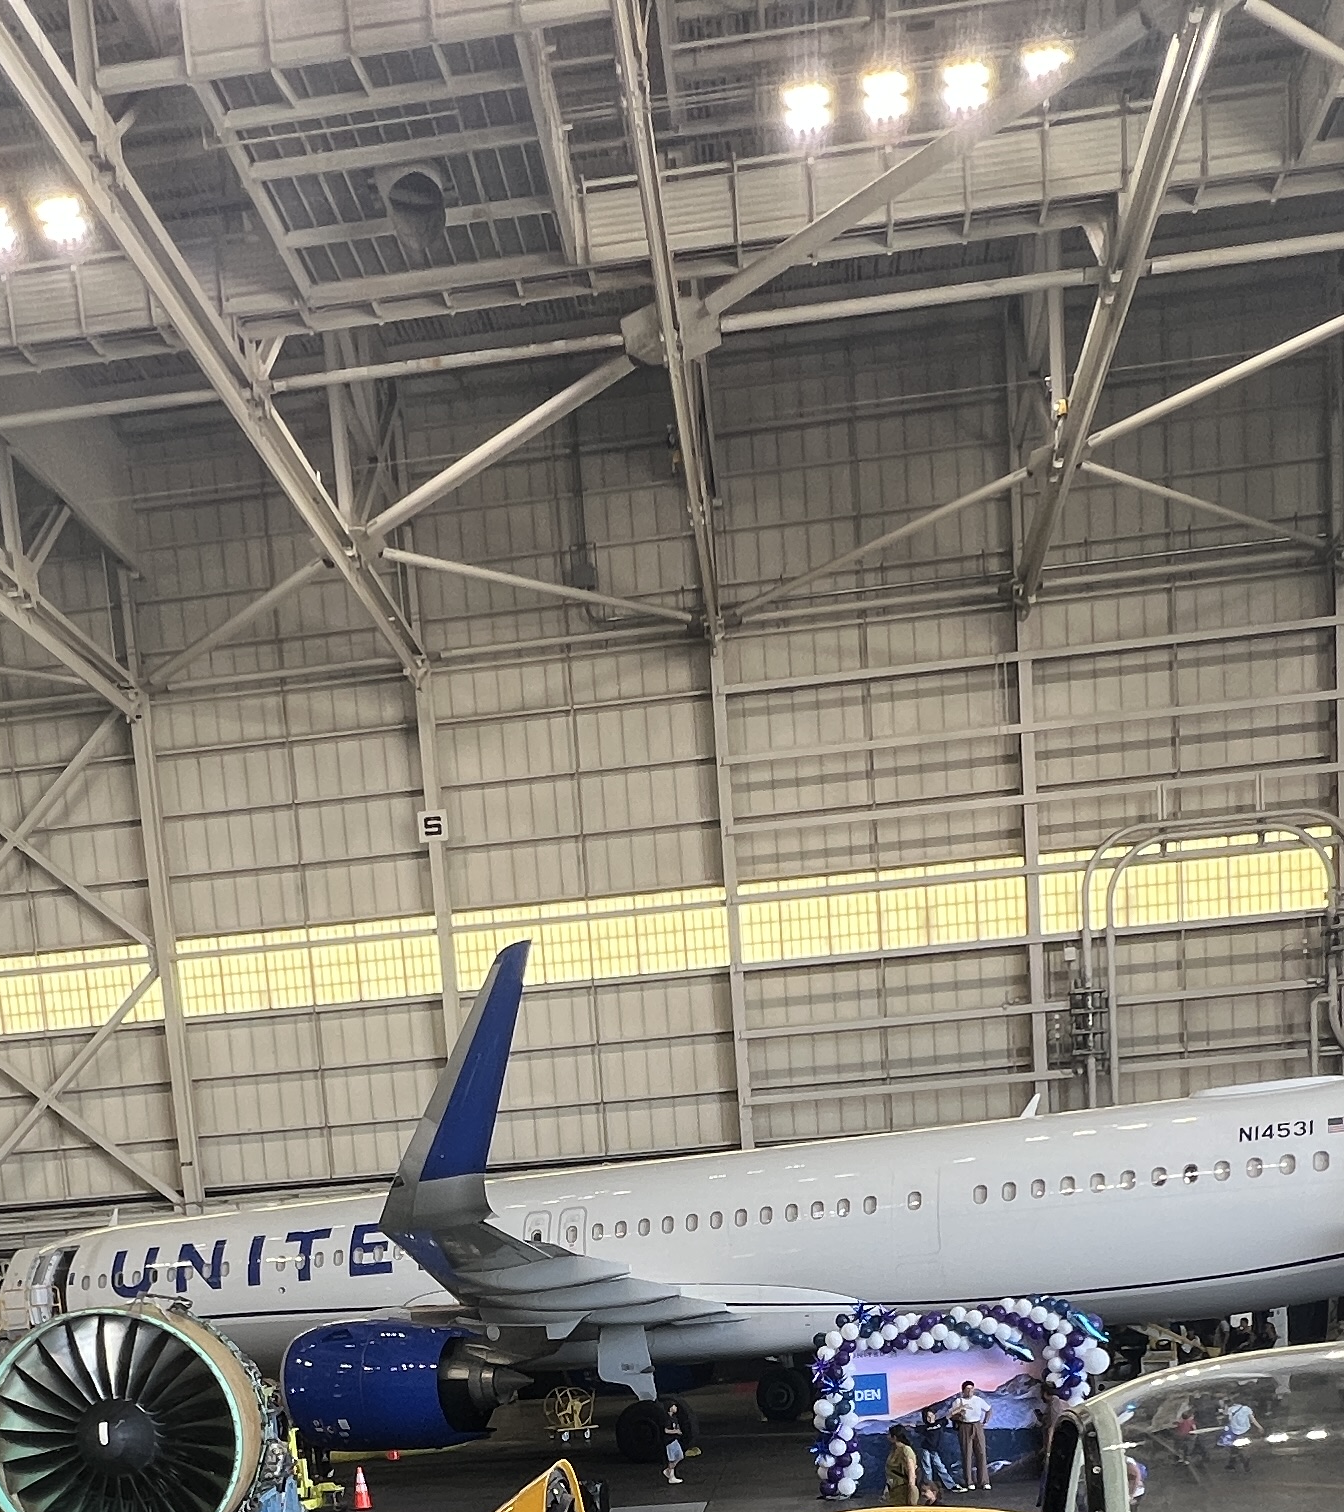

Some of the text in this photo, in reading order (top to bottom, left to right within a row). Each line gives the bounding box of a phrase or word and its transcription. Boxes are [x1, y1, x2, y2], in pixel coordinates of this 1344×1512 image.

[1239, 1120, 1313, 1142] N14531
[111, 1222, 427, 1298] UNITE
[855, 1389, 881, 1402] DEN
